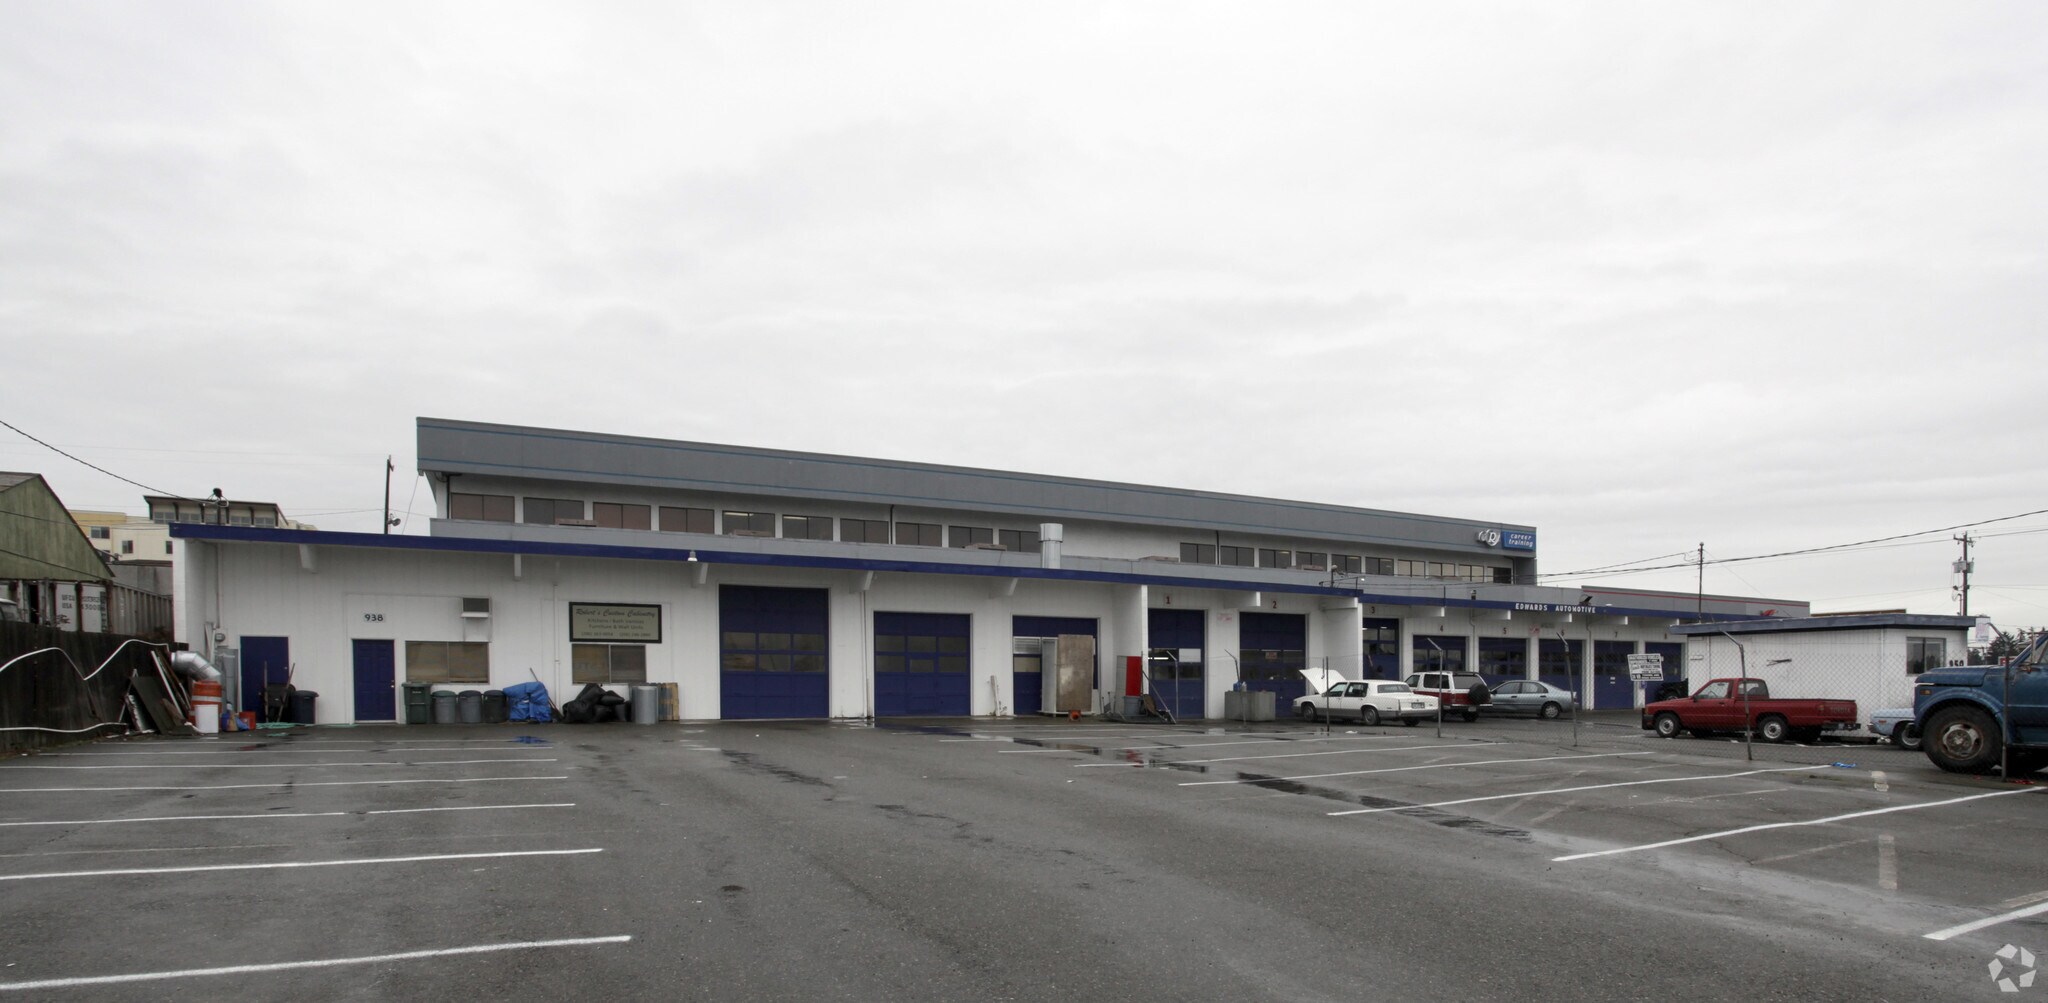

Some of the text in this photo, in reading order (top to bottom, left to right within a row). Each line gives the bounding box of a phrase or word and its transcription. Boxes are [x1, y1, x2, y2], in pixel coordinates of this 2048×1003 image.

[1508, 538, 1534, 548] training
[1272, 600, 1277, 608] 2
[1515, 602, 1596, 614] EDWARDS AUTOMOTIVE
[364, 614, 384, 622] 938
